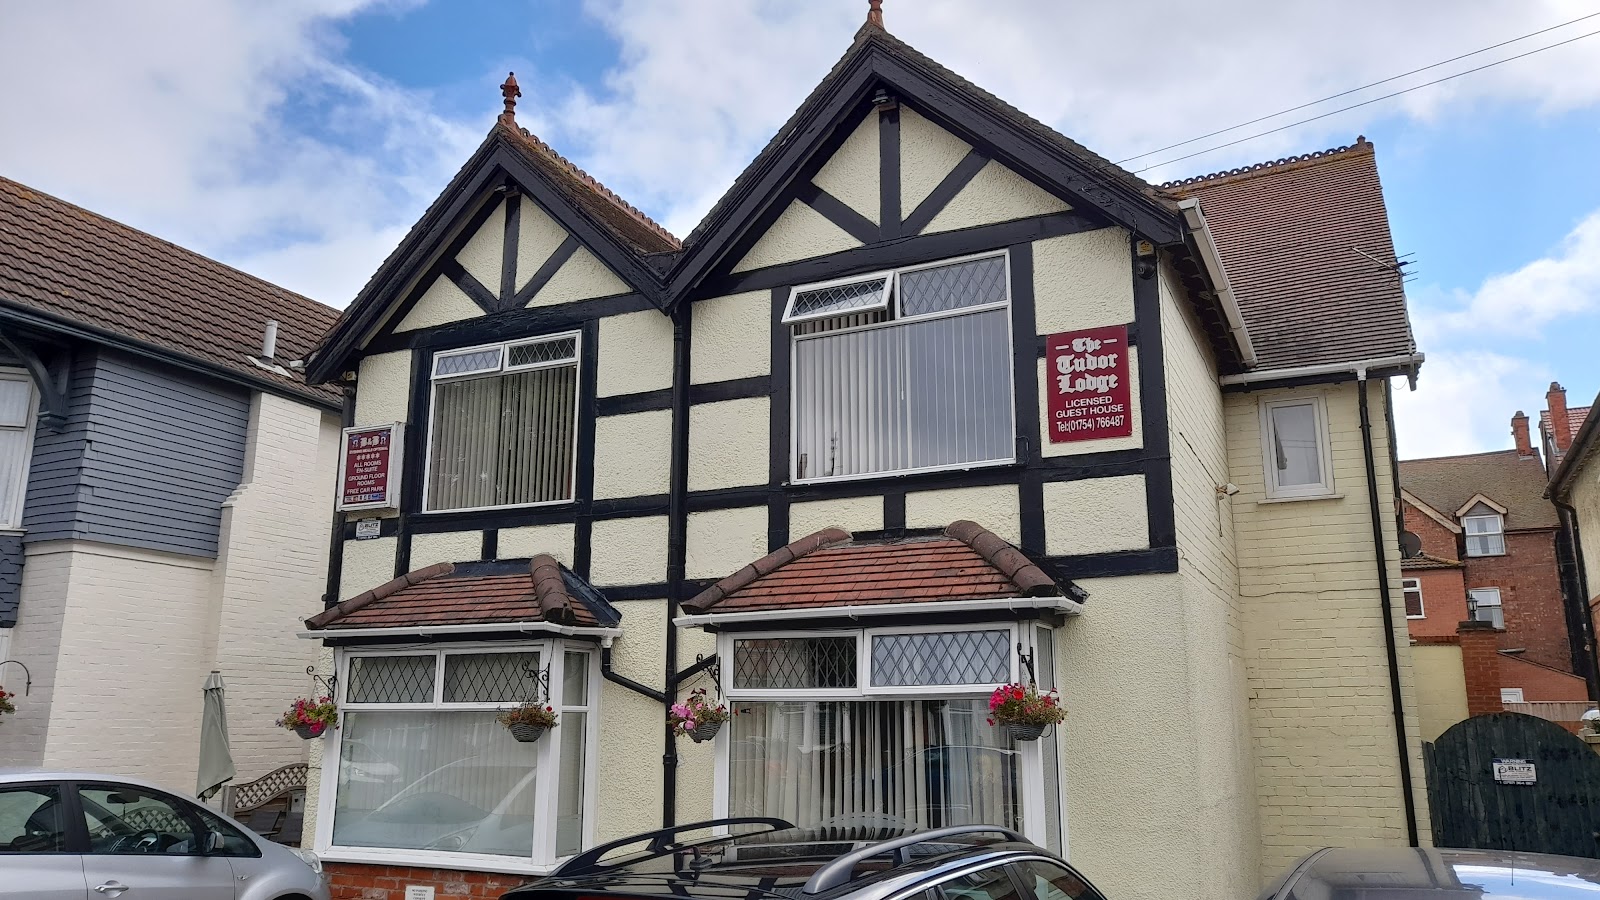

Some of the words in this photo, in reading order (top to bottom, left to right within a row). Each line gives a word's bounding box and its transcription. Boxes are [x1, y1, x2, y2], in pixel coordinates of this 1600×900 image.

[1072, 337, 1101, 353] The
[1055, 353, 1118, 374] Tudor
[1056, 373, 1118, 394] Lodge
[1065, 396, 1113, 408] LICENSED
[1056, 407, 1087, 418] GUEST
[1090, 404, 1124, 415] HOUSE
[1096, 415, 1124, 428] 766487
